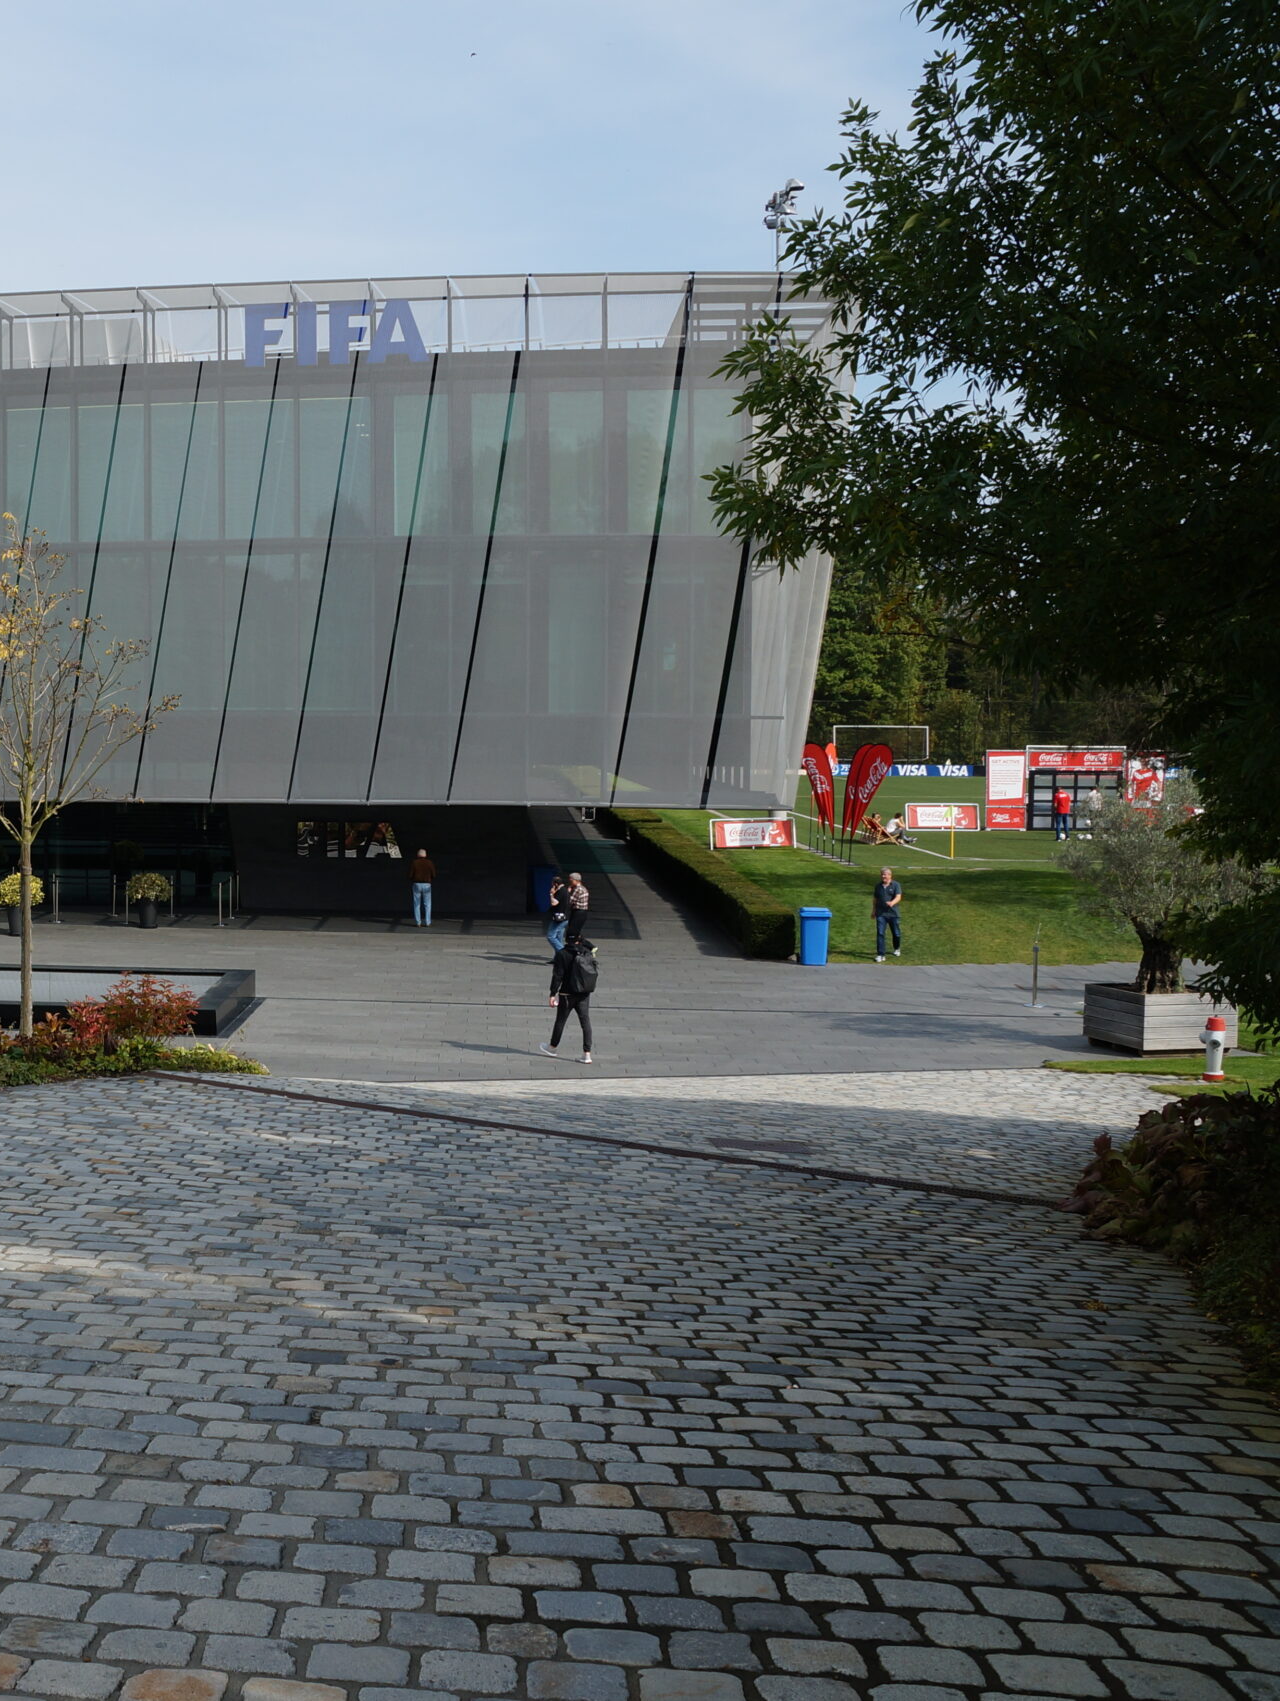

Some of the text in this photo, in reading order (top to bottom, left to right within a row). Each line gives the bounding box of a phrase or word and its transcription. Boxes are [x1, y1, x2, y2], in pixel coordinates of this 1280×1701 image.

[244, 300, 430, 367] FIFA
[895, 765, 927, 776] VISA
[936, 765, 968, 776] VISA
[297, 821, 402, 858] FIFA
